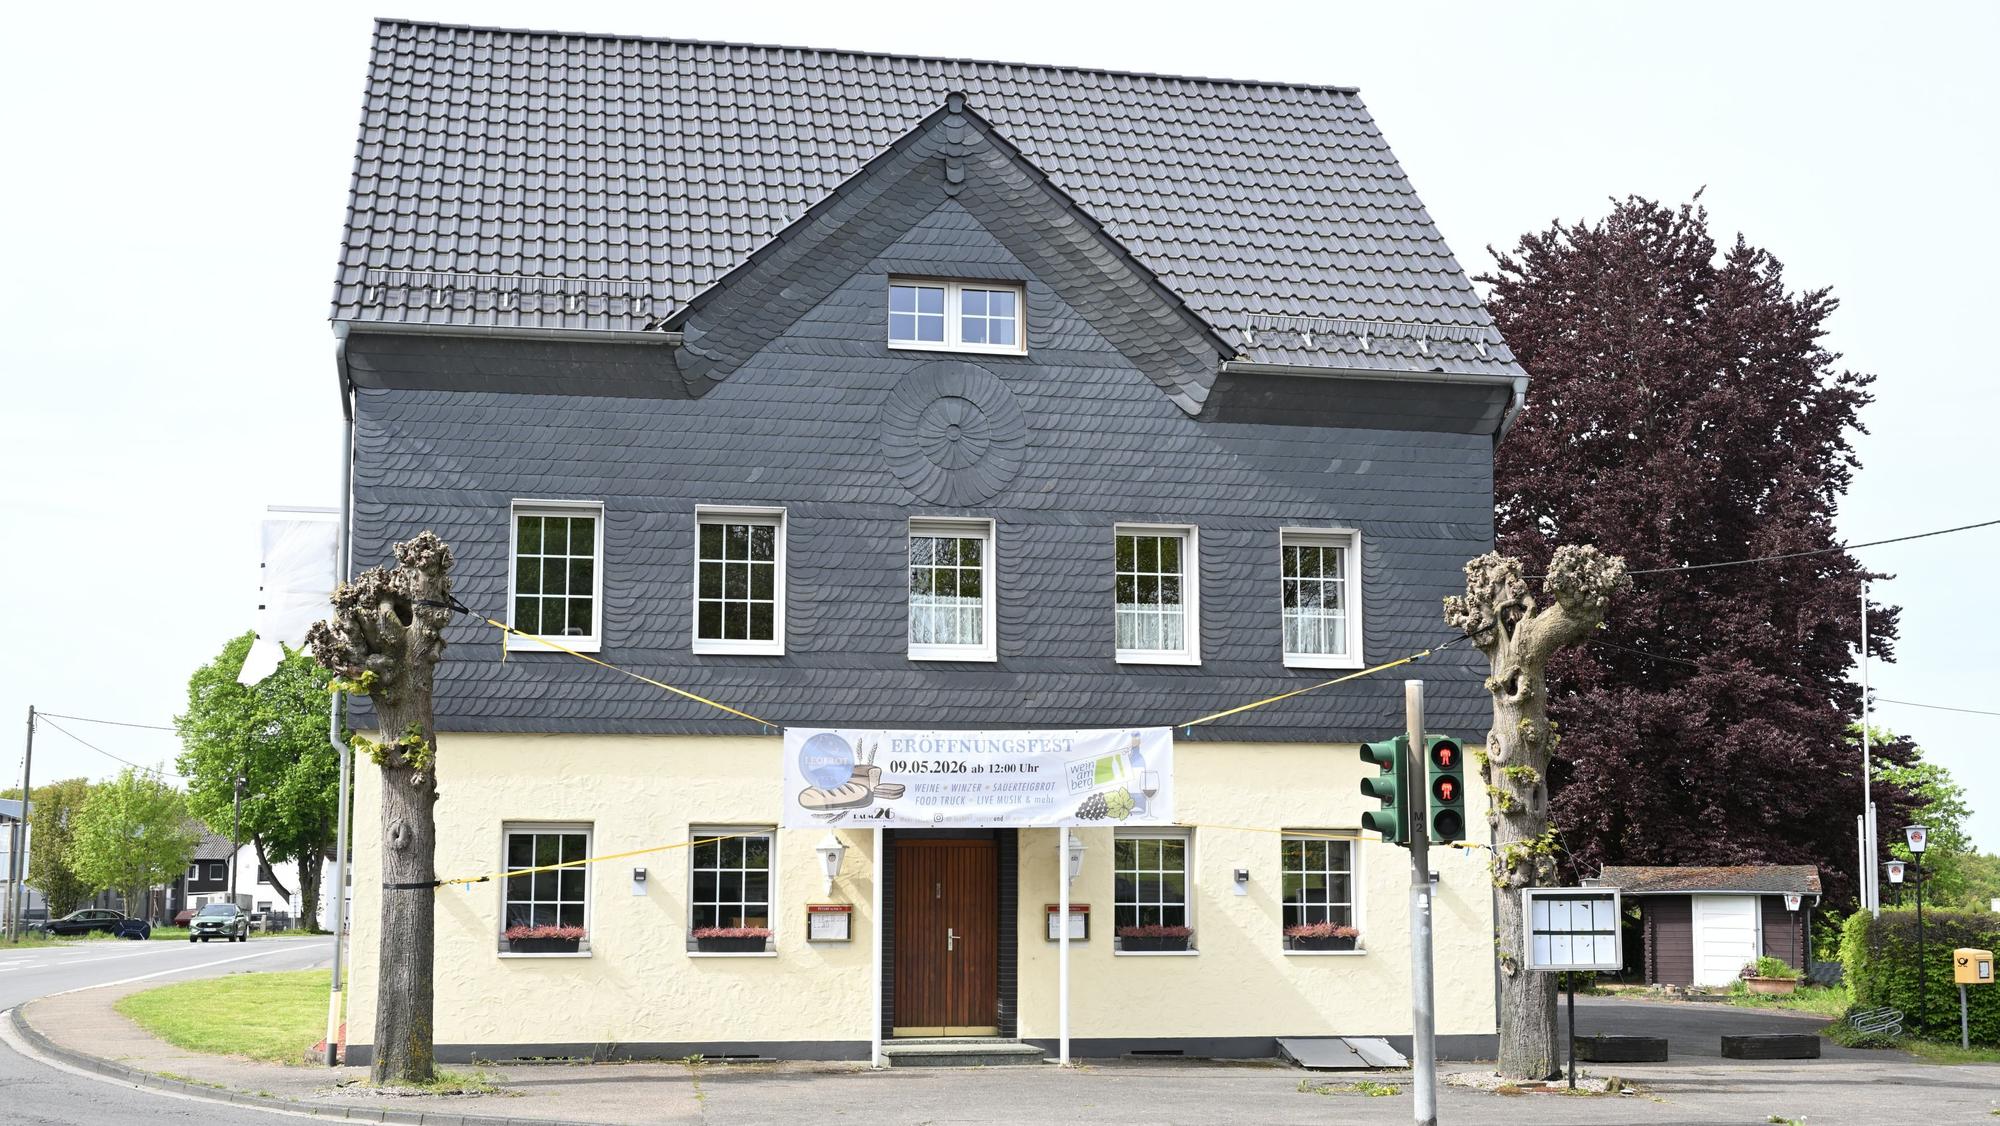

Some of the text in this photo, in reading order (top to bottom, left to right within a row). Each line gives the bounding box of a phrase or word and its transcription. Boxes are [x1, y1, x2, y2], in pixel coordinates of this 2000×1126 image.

[891, 735, 1073, 754] ERÖFFNUNGSFEST
[890, 760, 1039, 774] 09.05.2026 ab 12:00 Uhr
[1071, 761, 1094, 774] wein
[1077, 769, 1093, 780] am
[914, 782, 1056, 792] WEINE WINZER SAUERTEIGBROT
[1072, 778, 1093, 790] berg
[915, 796, 937, 805] FOOD
[940, 796, 965, 805] TRUCK
[977, 795, 994, 805] LIVE
[997, 795, 1022, 804] MUSIK
[1414, 811, 1424, 821] M
[1415, 823, 1423, 833] 2
